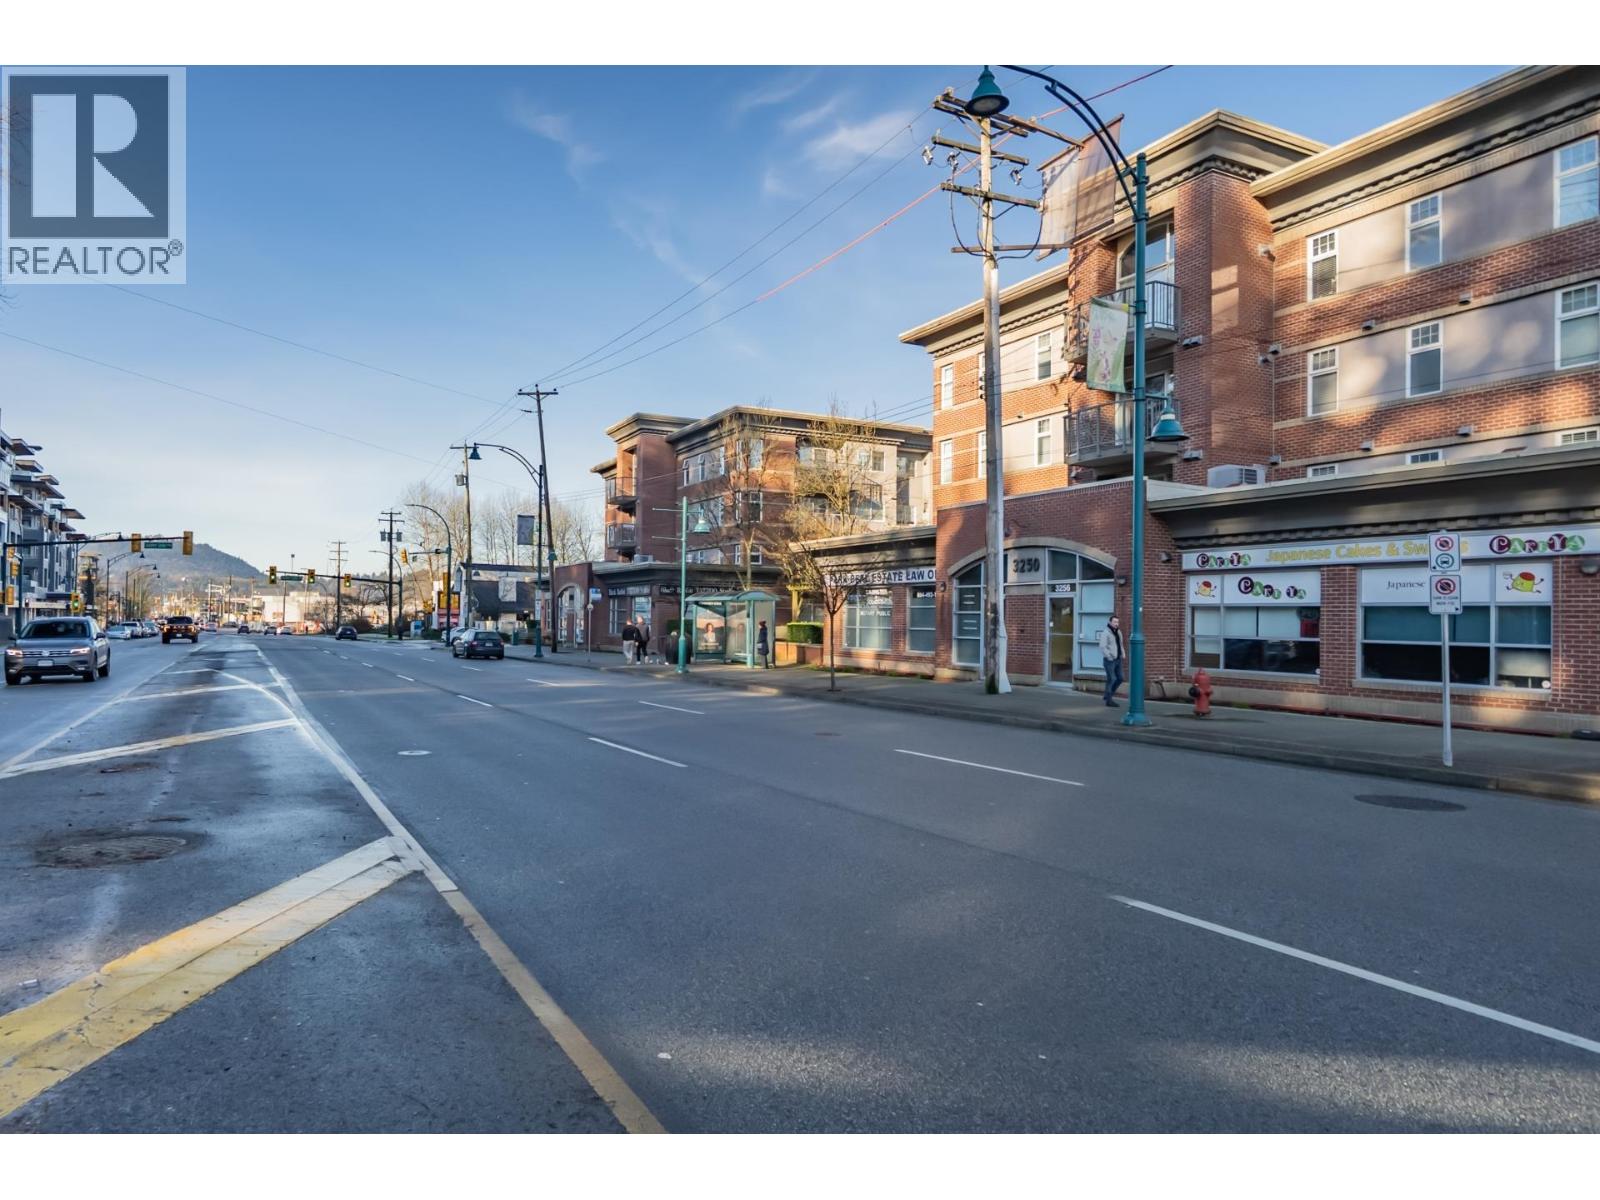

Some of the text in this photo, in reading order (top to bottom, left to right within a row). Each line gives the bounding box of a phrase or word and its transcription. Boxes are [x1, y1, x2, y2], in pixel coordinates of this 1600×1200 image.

[1266, 548, 1332, 564] Japanese
[1336, 543, 1381, 559] Cakes
[1386, 541, 1399, 556] &
[1013, 558, 1040, 573] 3250
[872, 571, 903, 583] ESTATE
[906, 570, 925, 581] LAW
[1386, 580, 1425, 590] Japanese
